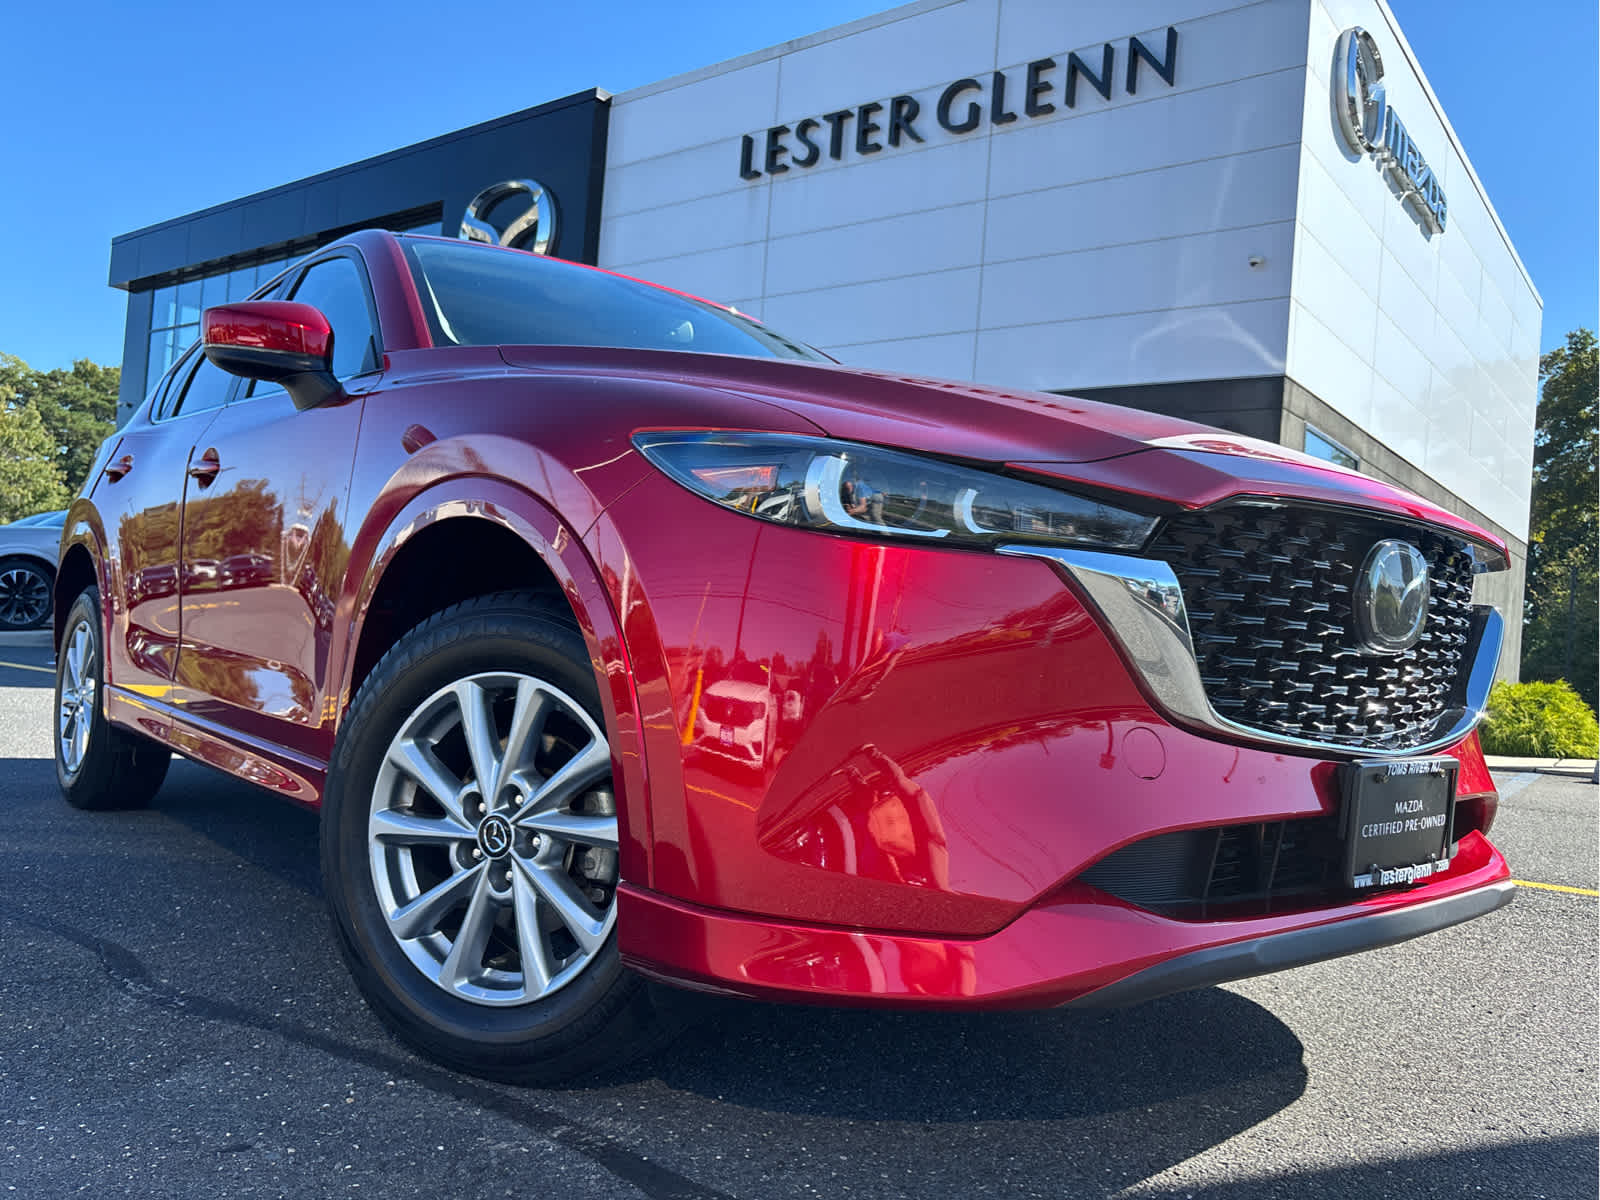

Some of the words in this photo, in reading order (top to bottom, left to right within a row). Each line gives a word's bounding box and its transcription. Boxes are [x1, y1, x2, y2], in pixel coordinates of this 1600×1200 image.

[739, 95, 925, 181] LESTER
[935, 26, 1178, 136] GLENN
[1384, 104, 1448, 234] mazda
[1387, 763, 1408, 776] TOMS
[1408, 761, 1429, 775] RIVER
[1395, 800, 1423, 814] MAZDA
[1362, 821, 1403, 838] CERTIFIED
[1404, 814, 1446, 832] PRE-OWNED
